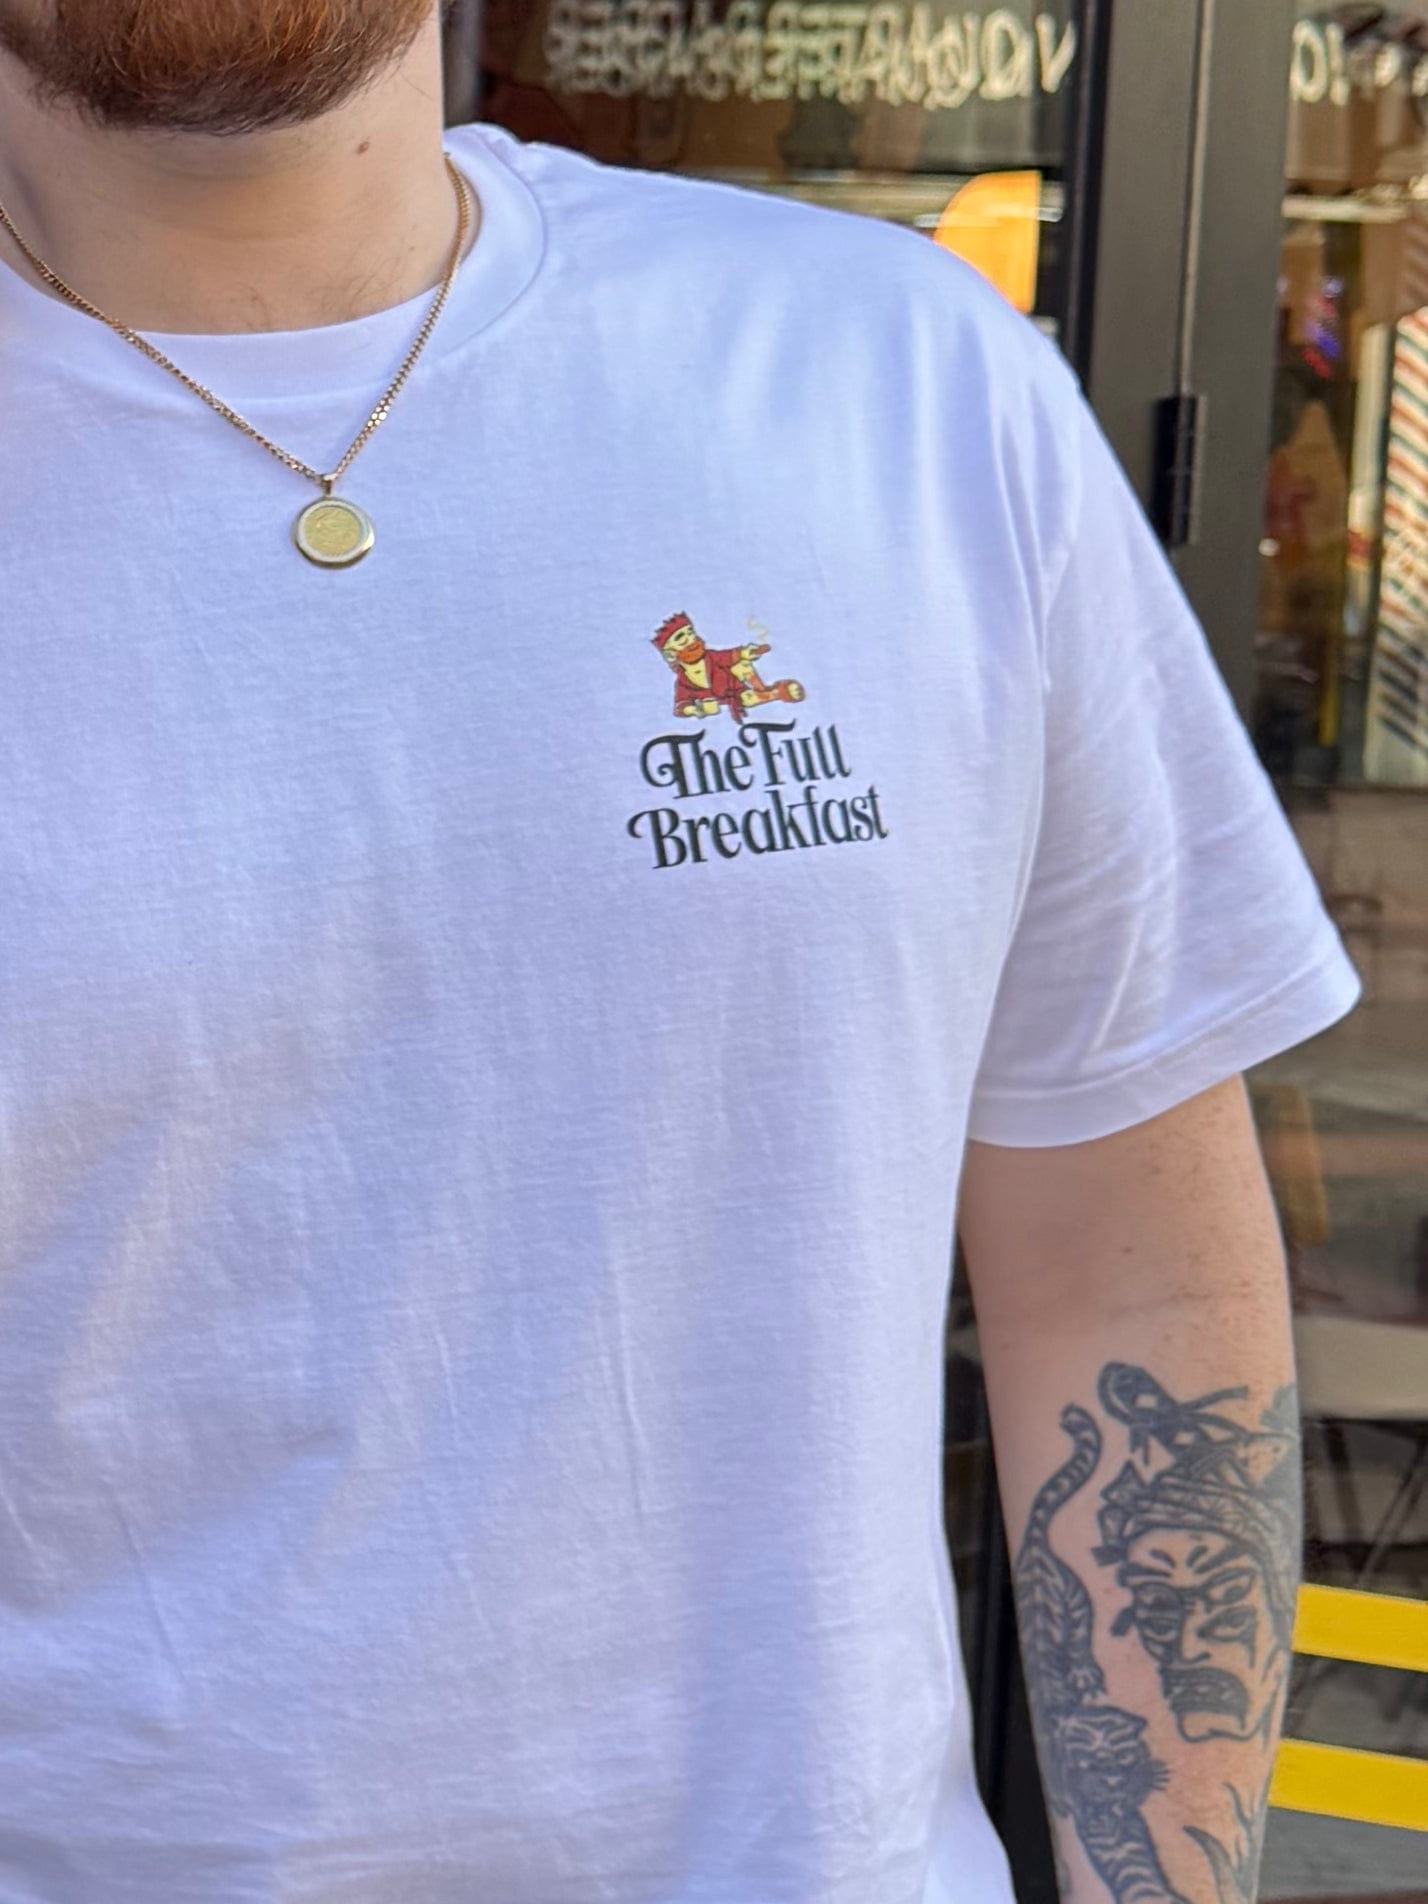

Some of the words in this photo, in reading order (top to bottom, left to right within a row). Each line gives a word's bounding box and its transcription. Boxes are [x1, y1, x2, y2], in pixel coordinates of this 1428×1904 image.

[640, 729, 754, 799] The
[738, 718, 853, 786] Full
[627, 785, 888, 869] Breakfast
